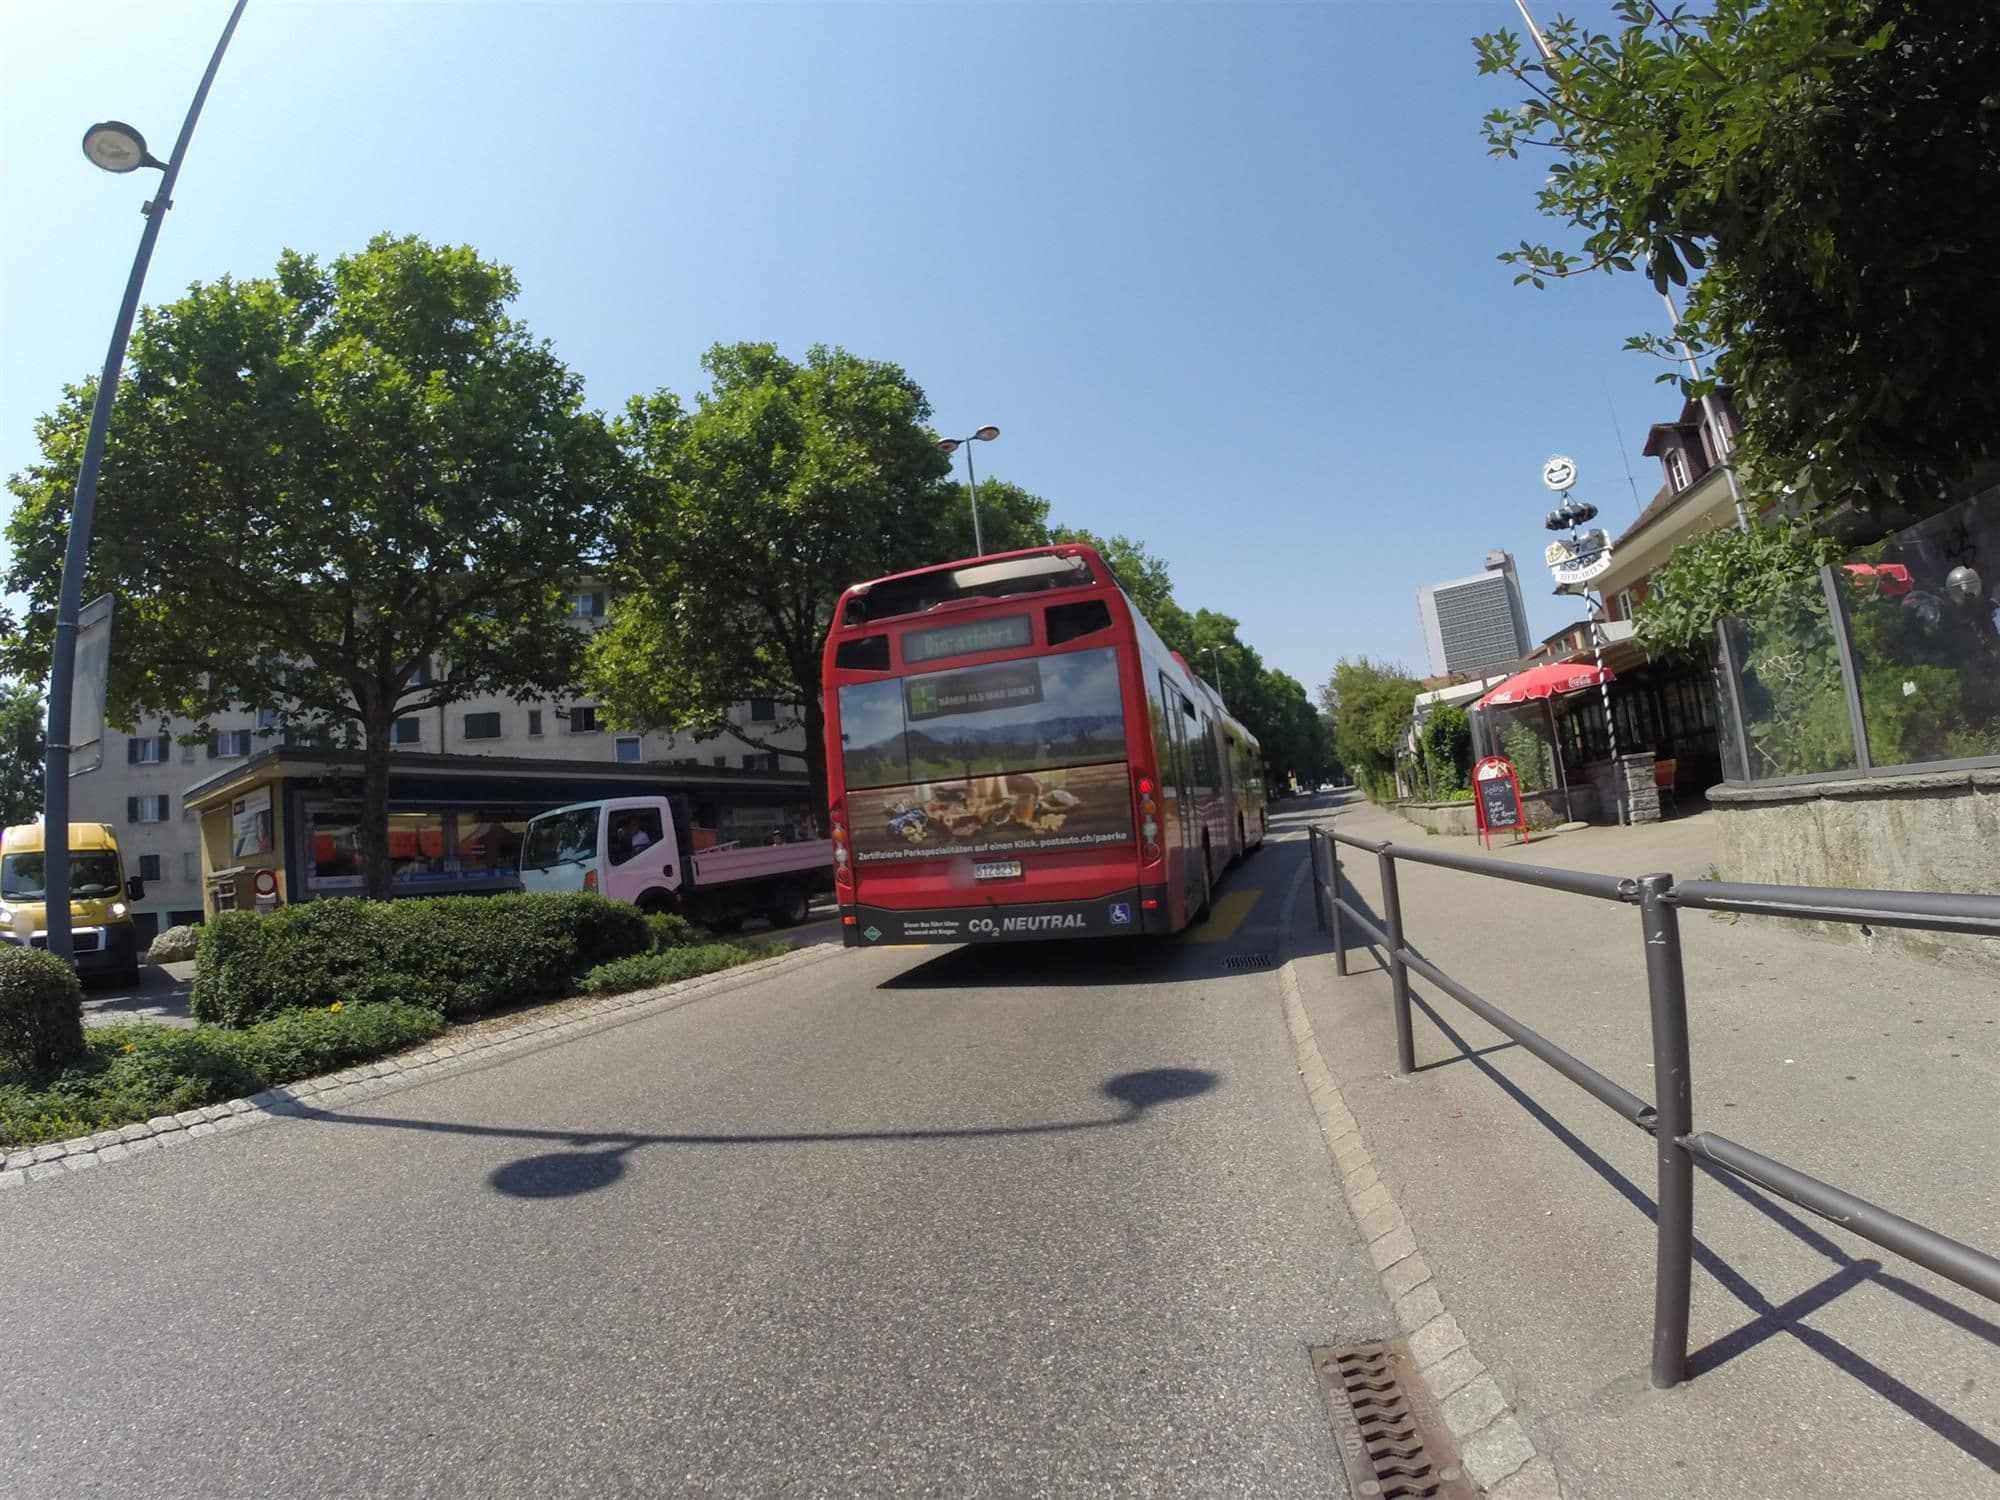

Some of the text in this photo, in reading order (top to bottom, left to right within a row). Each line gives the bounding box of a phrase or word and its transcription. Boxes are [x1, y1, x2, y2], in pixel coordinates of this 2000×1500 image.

[968, 691, 984, 702] ALS
[858, 849, 903, 861] Zertifizierte
[903, 844, 973, 857] Parkspezialitäten
[974, 842, 988, 852] auf
[989, 840, 1013, 850] einen
[1003, 913, 1086, 931] NEUTRAL
